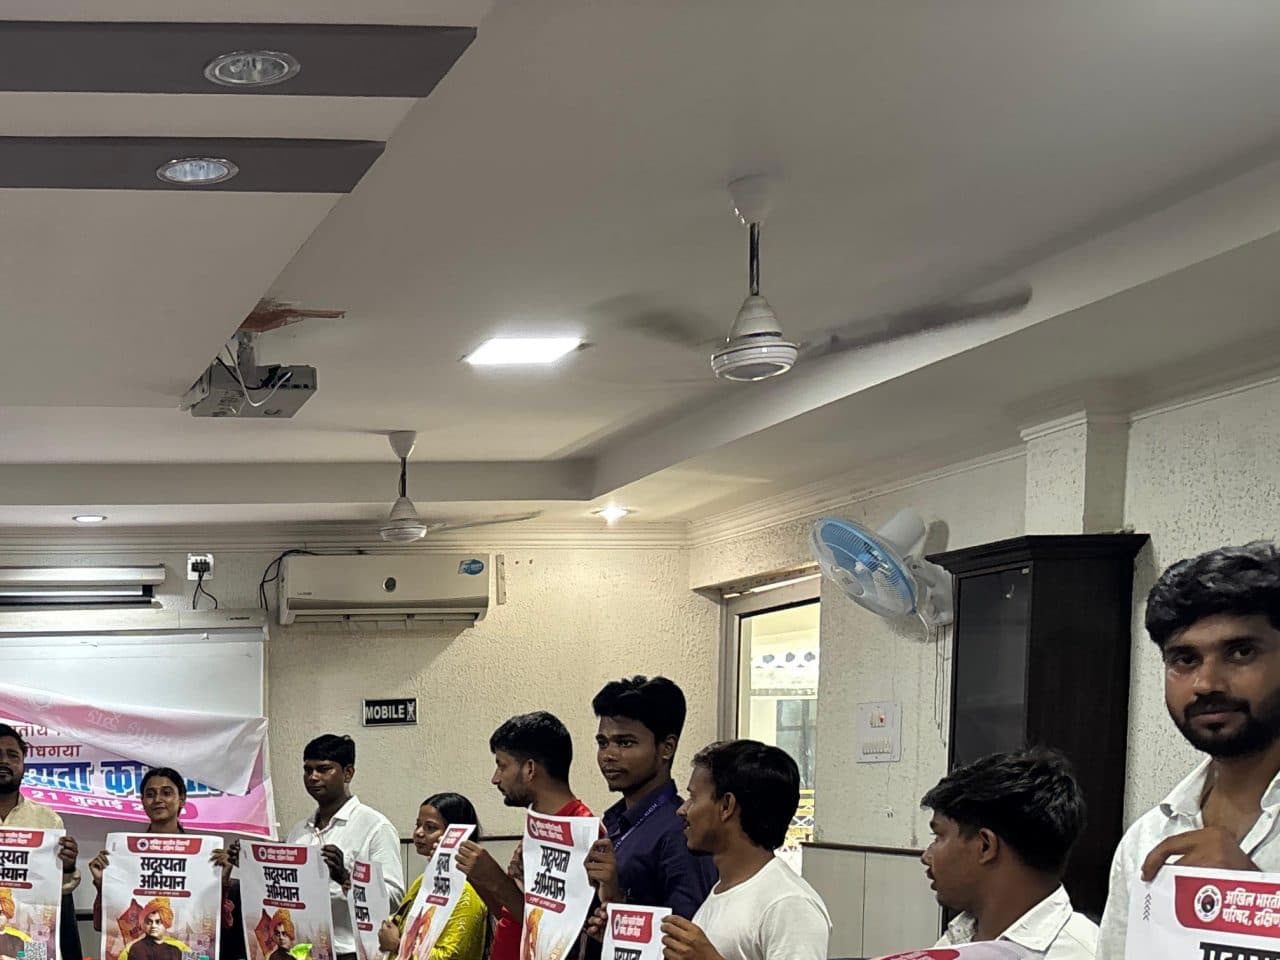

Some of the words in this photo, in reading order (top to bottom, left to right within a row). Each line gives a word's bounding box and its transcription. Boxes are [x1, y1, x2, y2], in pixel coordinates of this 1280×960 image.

[365, 705, 405, 720] MOBILE
[31, 789, 59, 801] 21
[69, 794, 123, 811] जुलाई
[140, 857, 187, 872] सदस्यता
[139, 871, 187, 890] अभियान
[263, 866, 298, 883] सदस्यता
[266, 880, 300, 902] अभियान
[1224, 887, 1256, 907] अखिल
